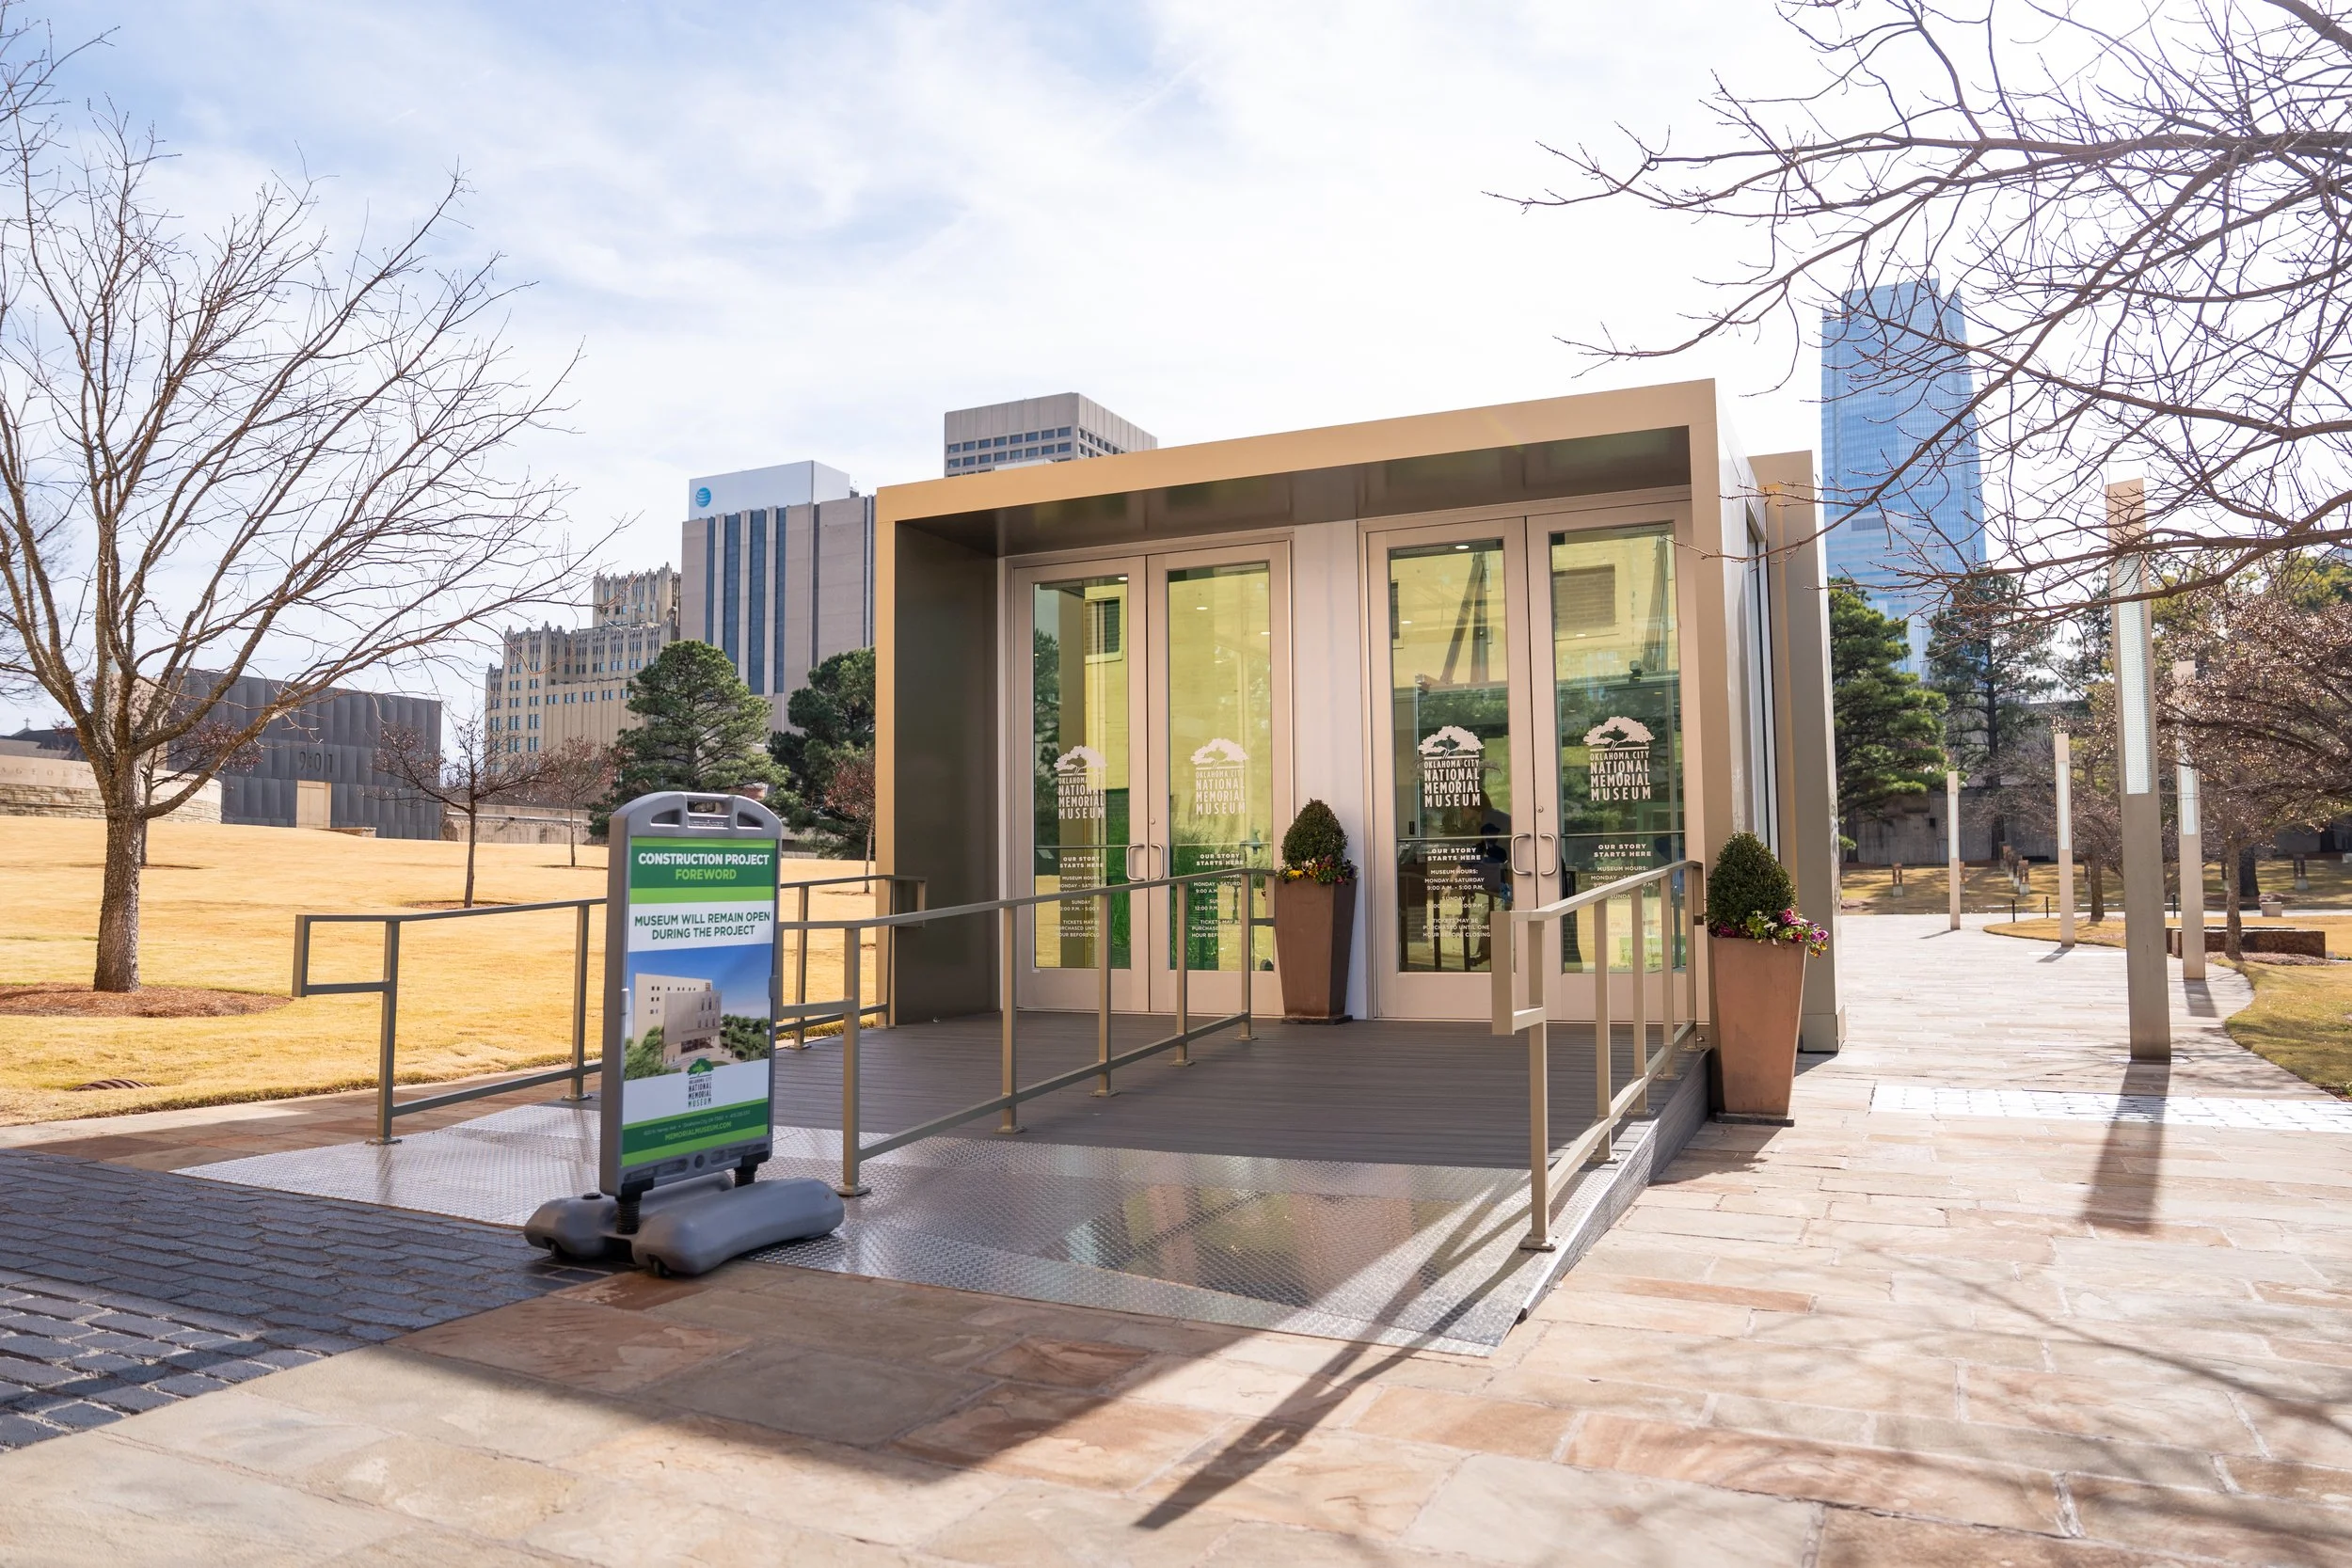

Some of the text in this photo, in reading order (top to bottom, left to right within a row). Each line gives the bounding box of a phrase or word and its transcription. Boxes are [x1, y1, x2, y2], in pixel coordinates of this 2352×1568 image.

[299, 752, 333, 772] 9:01
[1590, 752, 1629, 761] OKLAHOMA
[1424, 759, 1480, 768] OKLAHOMA CITY
[1590, 760, 1649, 774] NATIONAL
[1424, 768, 1480, 782] NATIONAL
[1591, 773, 1650, 787] MEMORIAL
[1058, 784, 1104, 796] NATIONAL
[1196, 778, 1245, 791] NATIONAL
[1424, 781, 1480, 794] MEMORIAL
[1196, 790, 1245, 802] MEMORIAL
[1591, 786, 1651, 801] MUSEUM
[1058, 796, 1104, 807] MEMORIAL
[1424, 794, 1481, 807] MUSEUM
[1058, 807, 1104, 819] MUSEUM
[1196, 801, 1246, 815] MUSEUM
[638, 852, 770, 865] CONSTRUCTION PROJECT
[675, 868, 737, 879] FOREWORD
[634, 911, 771, 927] MUSEUM WILL REMAIN OPEN
[652, 925, 755, 940] DURING THE PROJECT
[689, 1082, 712, 1092] NATIONAL
[689, 1090, 712, 1100] MEMORIAL
[689, 1098, 712, 1107] MUSEUM
[665, 1121, 732, 1141] MEMORIALMUSEUM.COM
